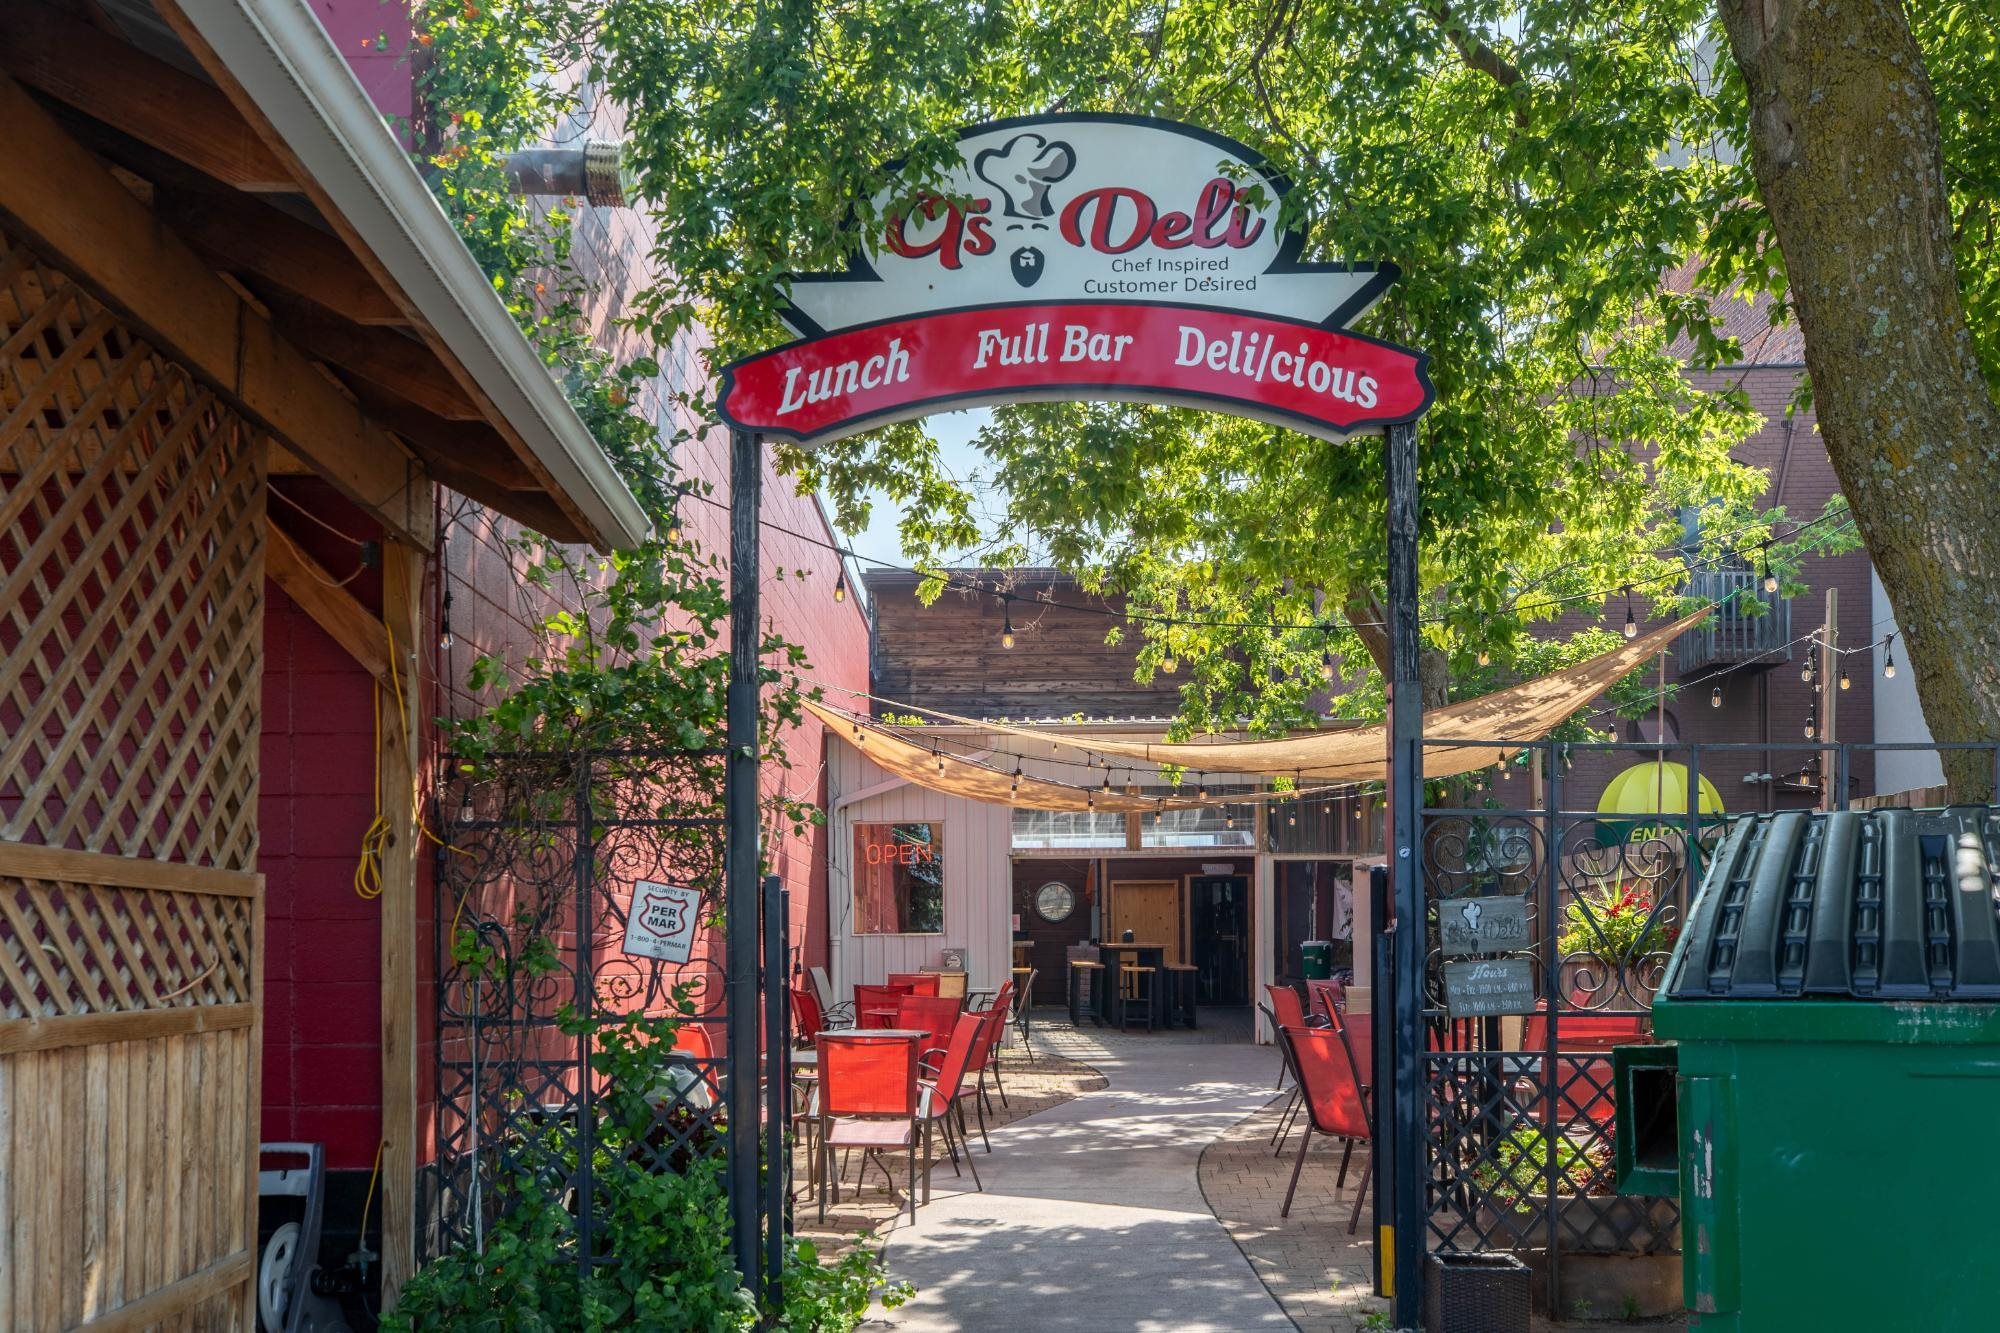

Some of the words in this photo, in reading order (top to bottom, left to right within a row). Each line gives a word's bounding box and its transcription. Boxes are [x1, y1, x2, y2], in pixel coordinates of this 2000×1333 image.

[1058, 177, 1267, 255] Deli
[1111, 257, 1152, 273] Chef
[1157, 256, 1230, 275] Inspired
[1083, 278, 1179, 295] Customer
[1184, 275, 1257, 293] Desired
[776, 338, 910, 415] Lunch
[973, 321, 1050, 371] Full
[1059, 324, 1134, 363] Bar
[1174, 326, 1379, 409] Deli/cious
[866, 844, 932, 865] OPEN
[647, 885, 679, 897] SECURITY
[651, 905, 677, 918] PER
[647, 916, 677, 930] MAR
[1468, 963, 1508, 980] Hours
